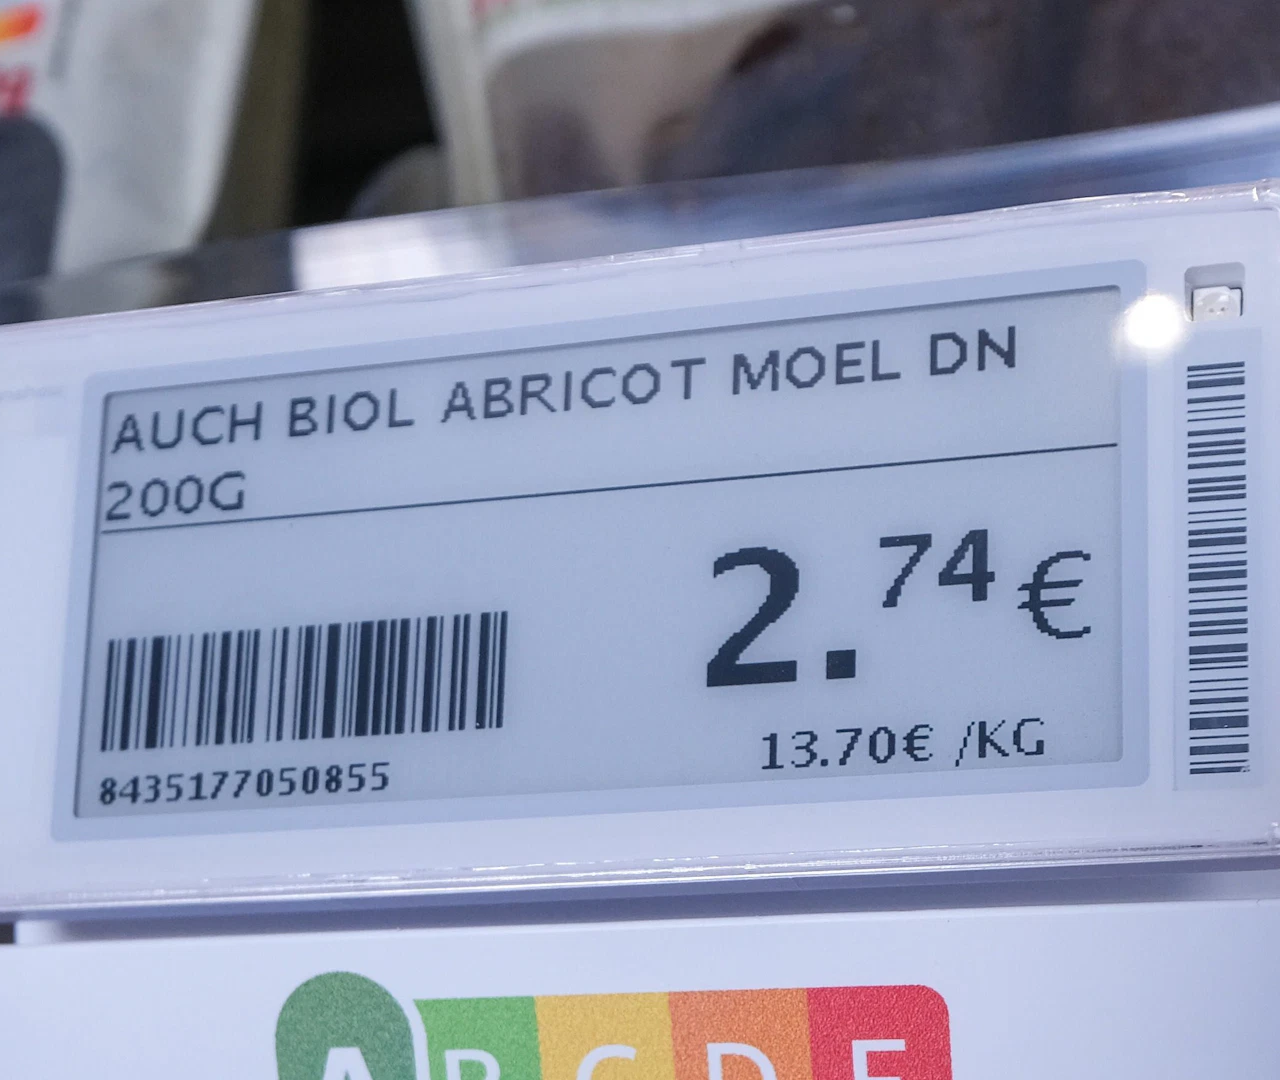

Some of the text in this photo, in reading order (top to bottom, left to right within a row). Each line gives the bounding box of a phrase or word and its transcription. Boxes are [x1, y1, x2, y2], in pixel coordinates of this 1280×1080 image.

[111, 326, 1017, 454] AUCH BIOL ABRICOT MOEL DN
[105, 471, 246, 520] 200G
[761, 717, 1044, 770] 13.70€ /KG
[100, 762, 390, 806] 8435177050855
